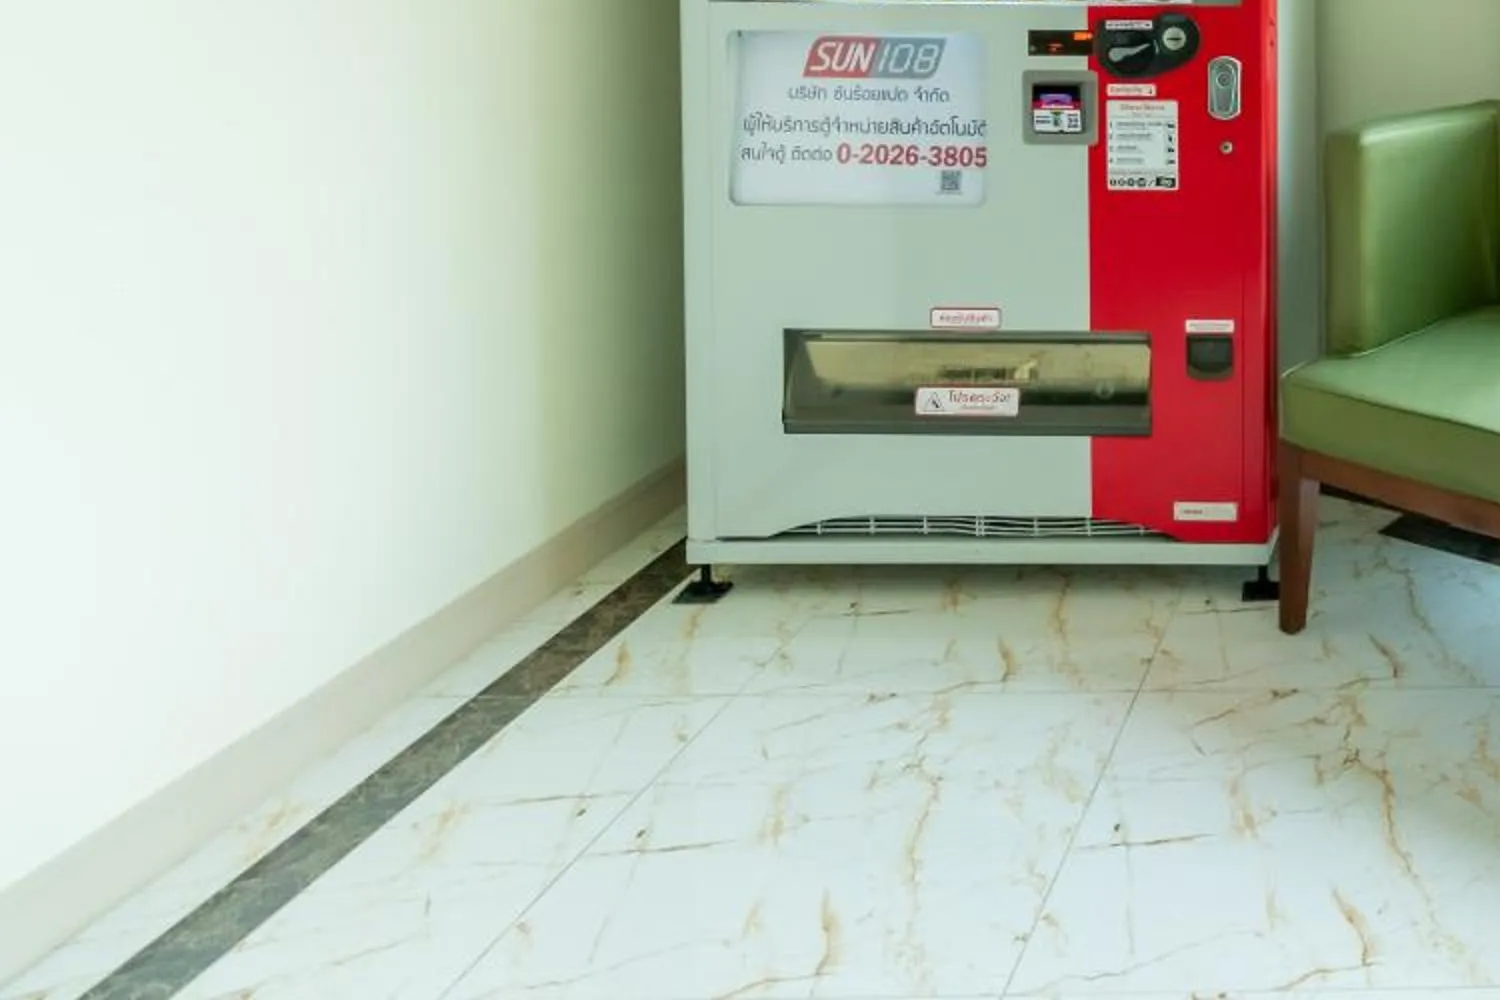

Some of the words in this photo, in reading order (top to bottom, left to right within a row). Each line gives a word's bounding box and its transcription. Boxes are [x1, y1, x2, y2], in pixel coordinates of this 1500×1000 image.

[788, 85, 827, 101] บริษัท
[914, 86, 950, 102] จำกัด
[837, 142, 987, 168] 0-2026-3805
